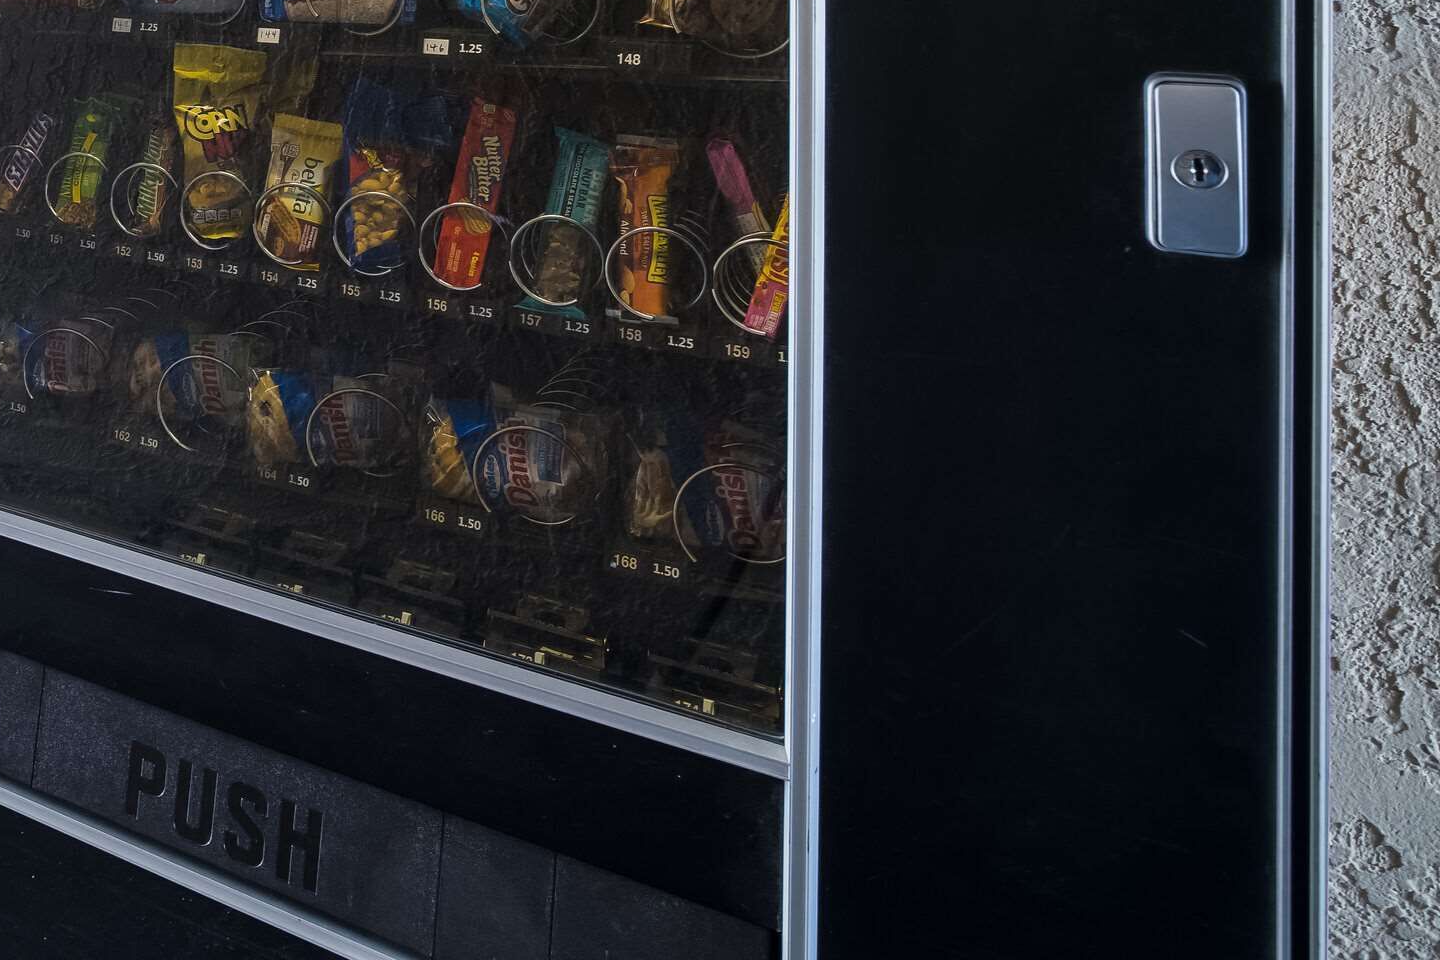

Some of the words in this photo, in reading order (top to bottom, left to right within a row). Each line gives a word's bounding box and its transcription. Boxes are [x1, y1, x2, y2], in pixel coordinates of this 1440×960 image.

[140, 22, 158, 32] 1.25
[459, 43, 483, 55] 1.25
[616, 52, 641, 66] 148
[483, 135, 500, 182] Nutter
[471, 155, 490, 203] Butter
[80, 240, 96, 249] 1.50
[620, 220, 630, 256] Almnd
[116, 246, 132, 257] 152
[147, 251, 165, 263] 1.50
[186, 257, 203, 270] 153
[219, 263, 238, 275] 1.25
[260, 271, 279, 283] 154
[297, 277, 317, 289] 1.25
[341, 284, 360, 297] 155
[379, 290, 401, 302] 1.25
[426, 298, 447, 312] 156
[469, 305, 493, 318] 1.25
[520, 313, 542, 327] 157
[564, 320, 591, 334] 1.25
[618, 327, 643, 341] 158
[667, 335, 695, 349] 1.25
[724, 343, 750, 359] 159
[10, 402, 27, 414] 1.50
[113, 429, 131, 442] 162
[140, 436, 159, 448] 1.50
[288, 473, 311, 488] 1.50
[424, 509, 445, 524] 166
[458, 516, 481, 531] 1.50
[613, 553, 638, 570] 168
[653, 563, 680, 579] 1.50
[126, 739, 325, 897] PUSH
